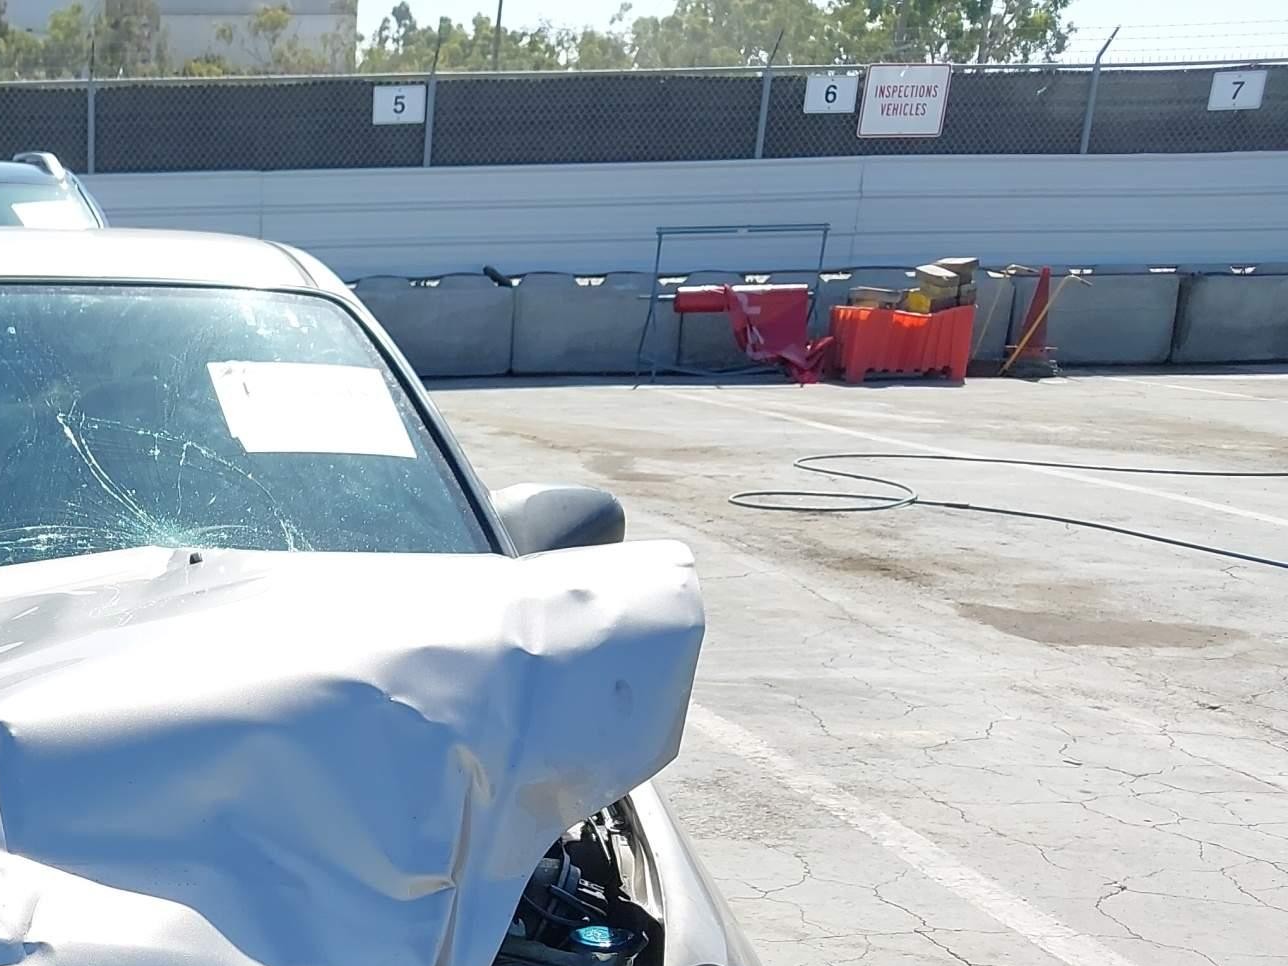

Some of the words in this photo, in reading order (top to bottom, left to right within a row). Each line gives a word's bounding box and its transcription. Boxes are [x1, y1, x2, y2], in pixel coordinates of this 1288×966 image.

[824, 84, 838, 104] 6
[874, 84, 940, 99] INSPECTIONS
[1232, 81, 1245, 100] 7
[393, 95, 406, 114] 5
[880, 102, 928, 117] VEHICLES
